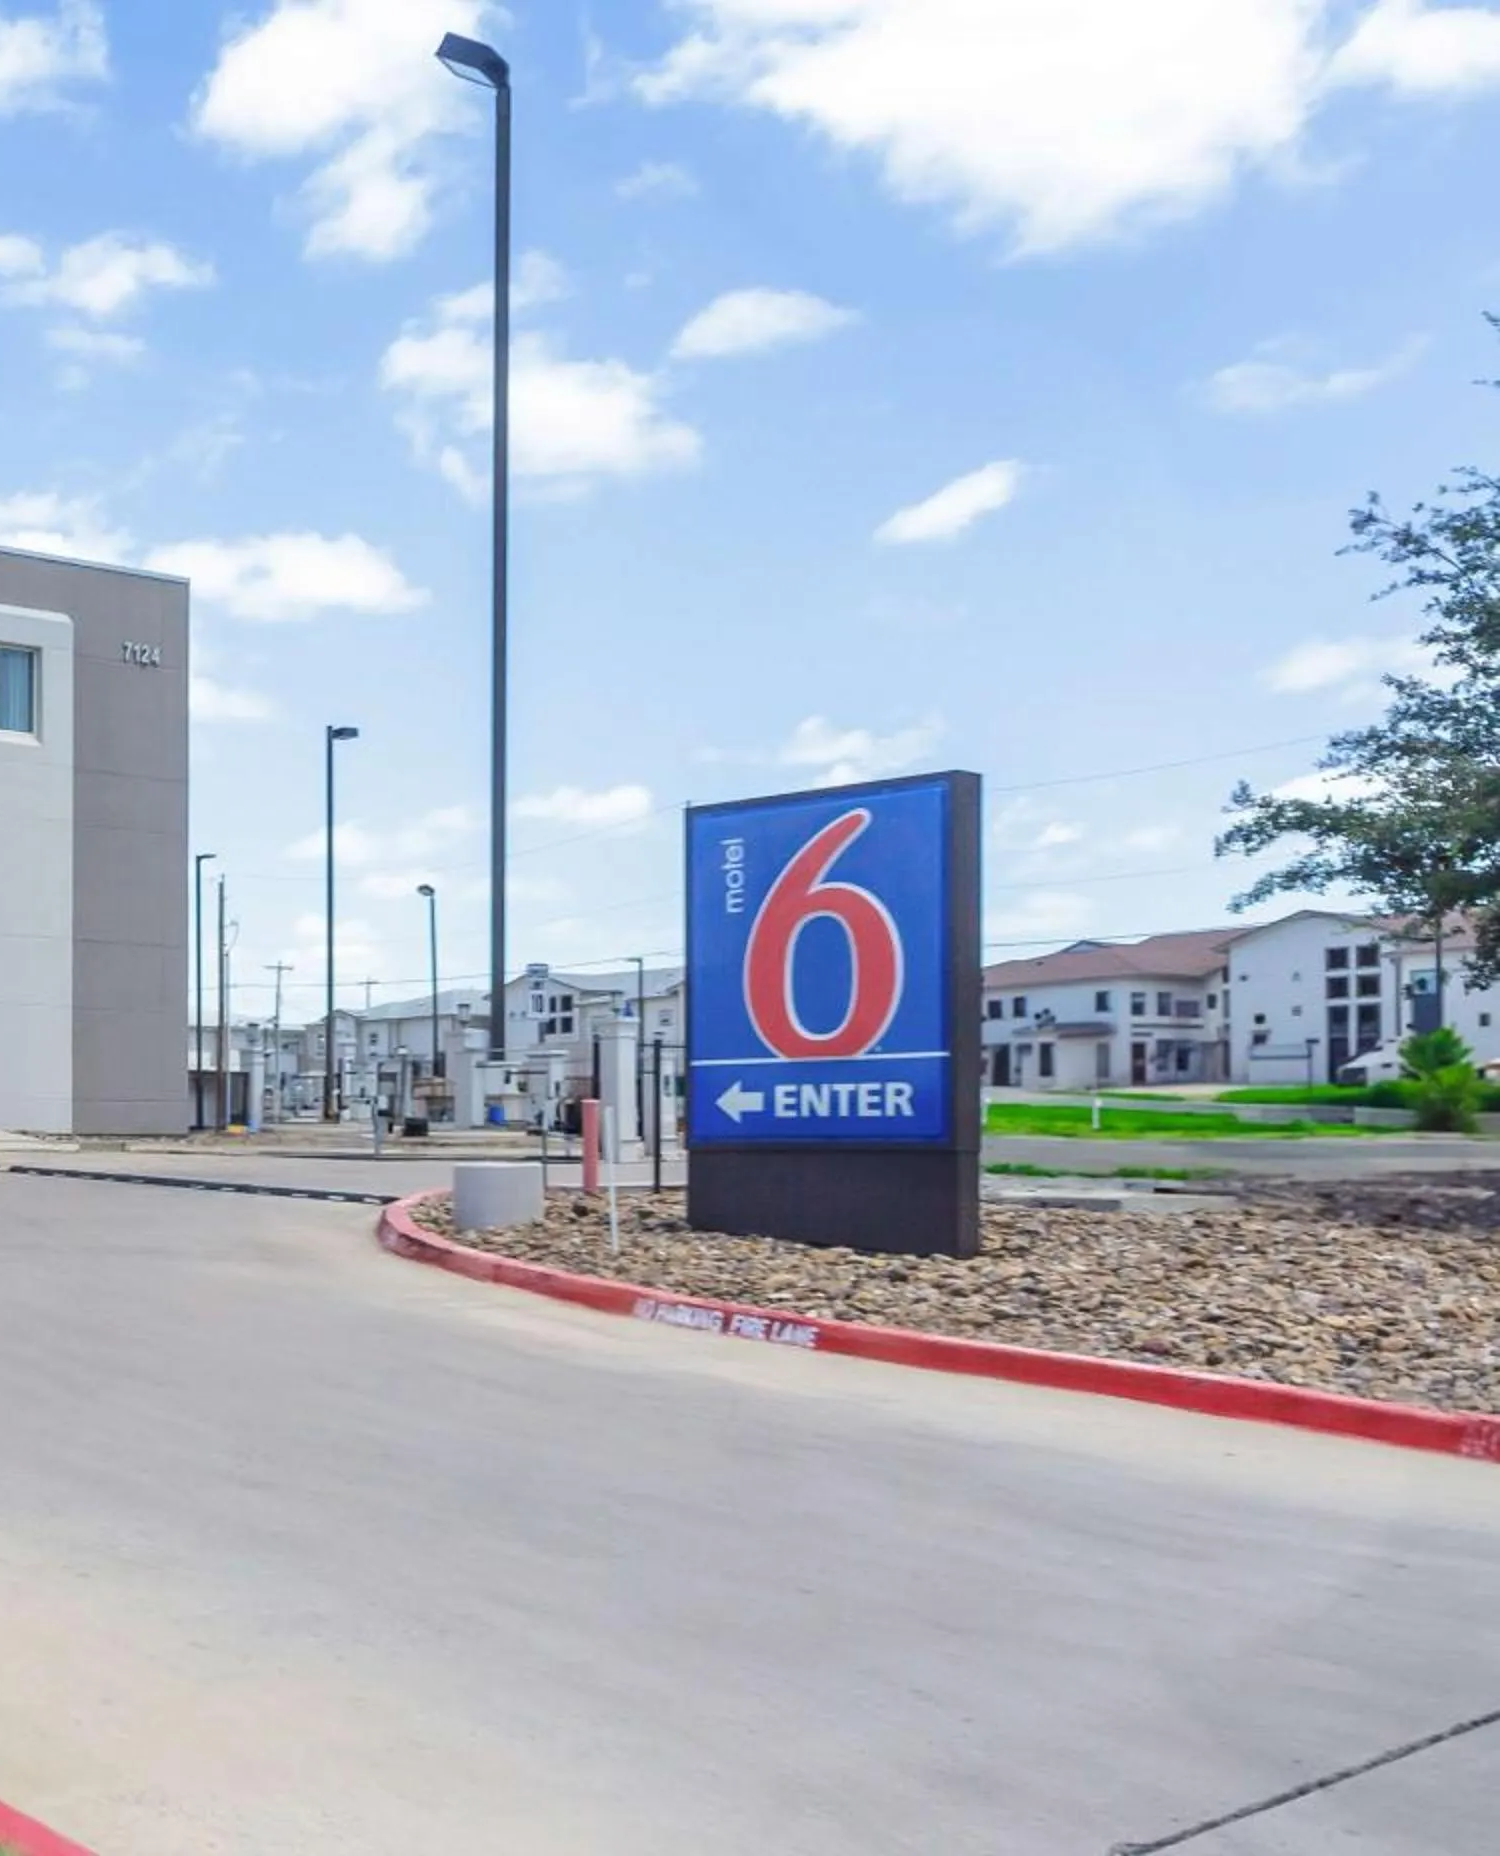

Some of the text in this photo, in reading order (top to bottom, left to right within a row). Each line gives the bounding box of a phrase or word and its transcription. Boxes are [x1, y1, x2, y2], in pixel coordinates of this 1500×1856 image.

[122, 641, 161, 665] 7124
[720, 838, 745, 913] motel
[743, 808, 904, 1060] 6
[774, 1081, 914, 1118] ENTER
